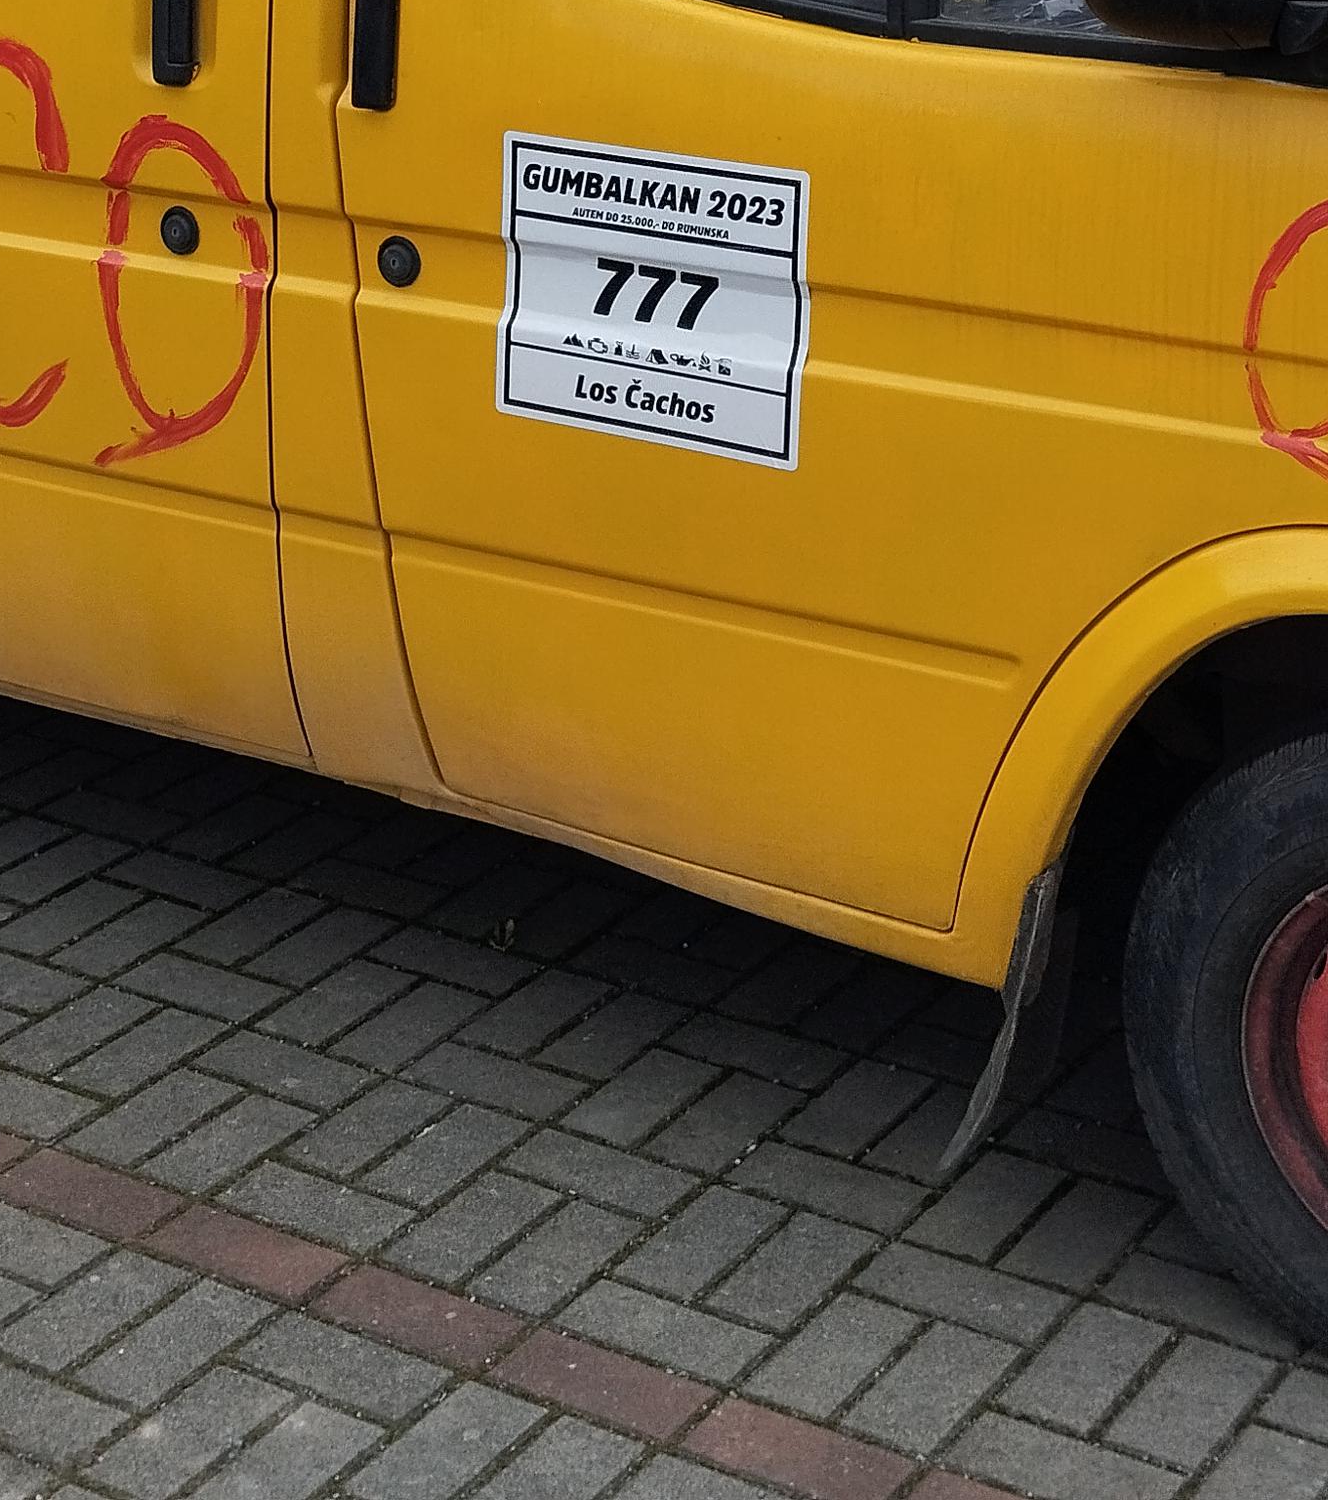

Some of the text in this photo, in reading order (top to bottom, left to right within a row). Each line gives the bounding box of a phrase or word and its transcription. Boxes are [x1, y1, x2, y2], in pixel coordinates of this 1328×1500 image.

[522, 163, 786, 227] GUMBALKAN 2023
[572, 207, 604, 220] AUTEM
[605, 211, 619, 222] DO
[661, 220, 675, 231] DO
[677, 222, 730, 240] RUMUNSKA
[593, 257, 720, 331] 777
[574, 374, 715, 424] Los Čachos
